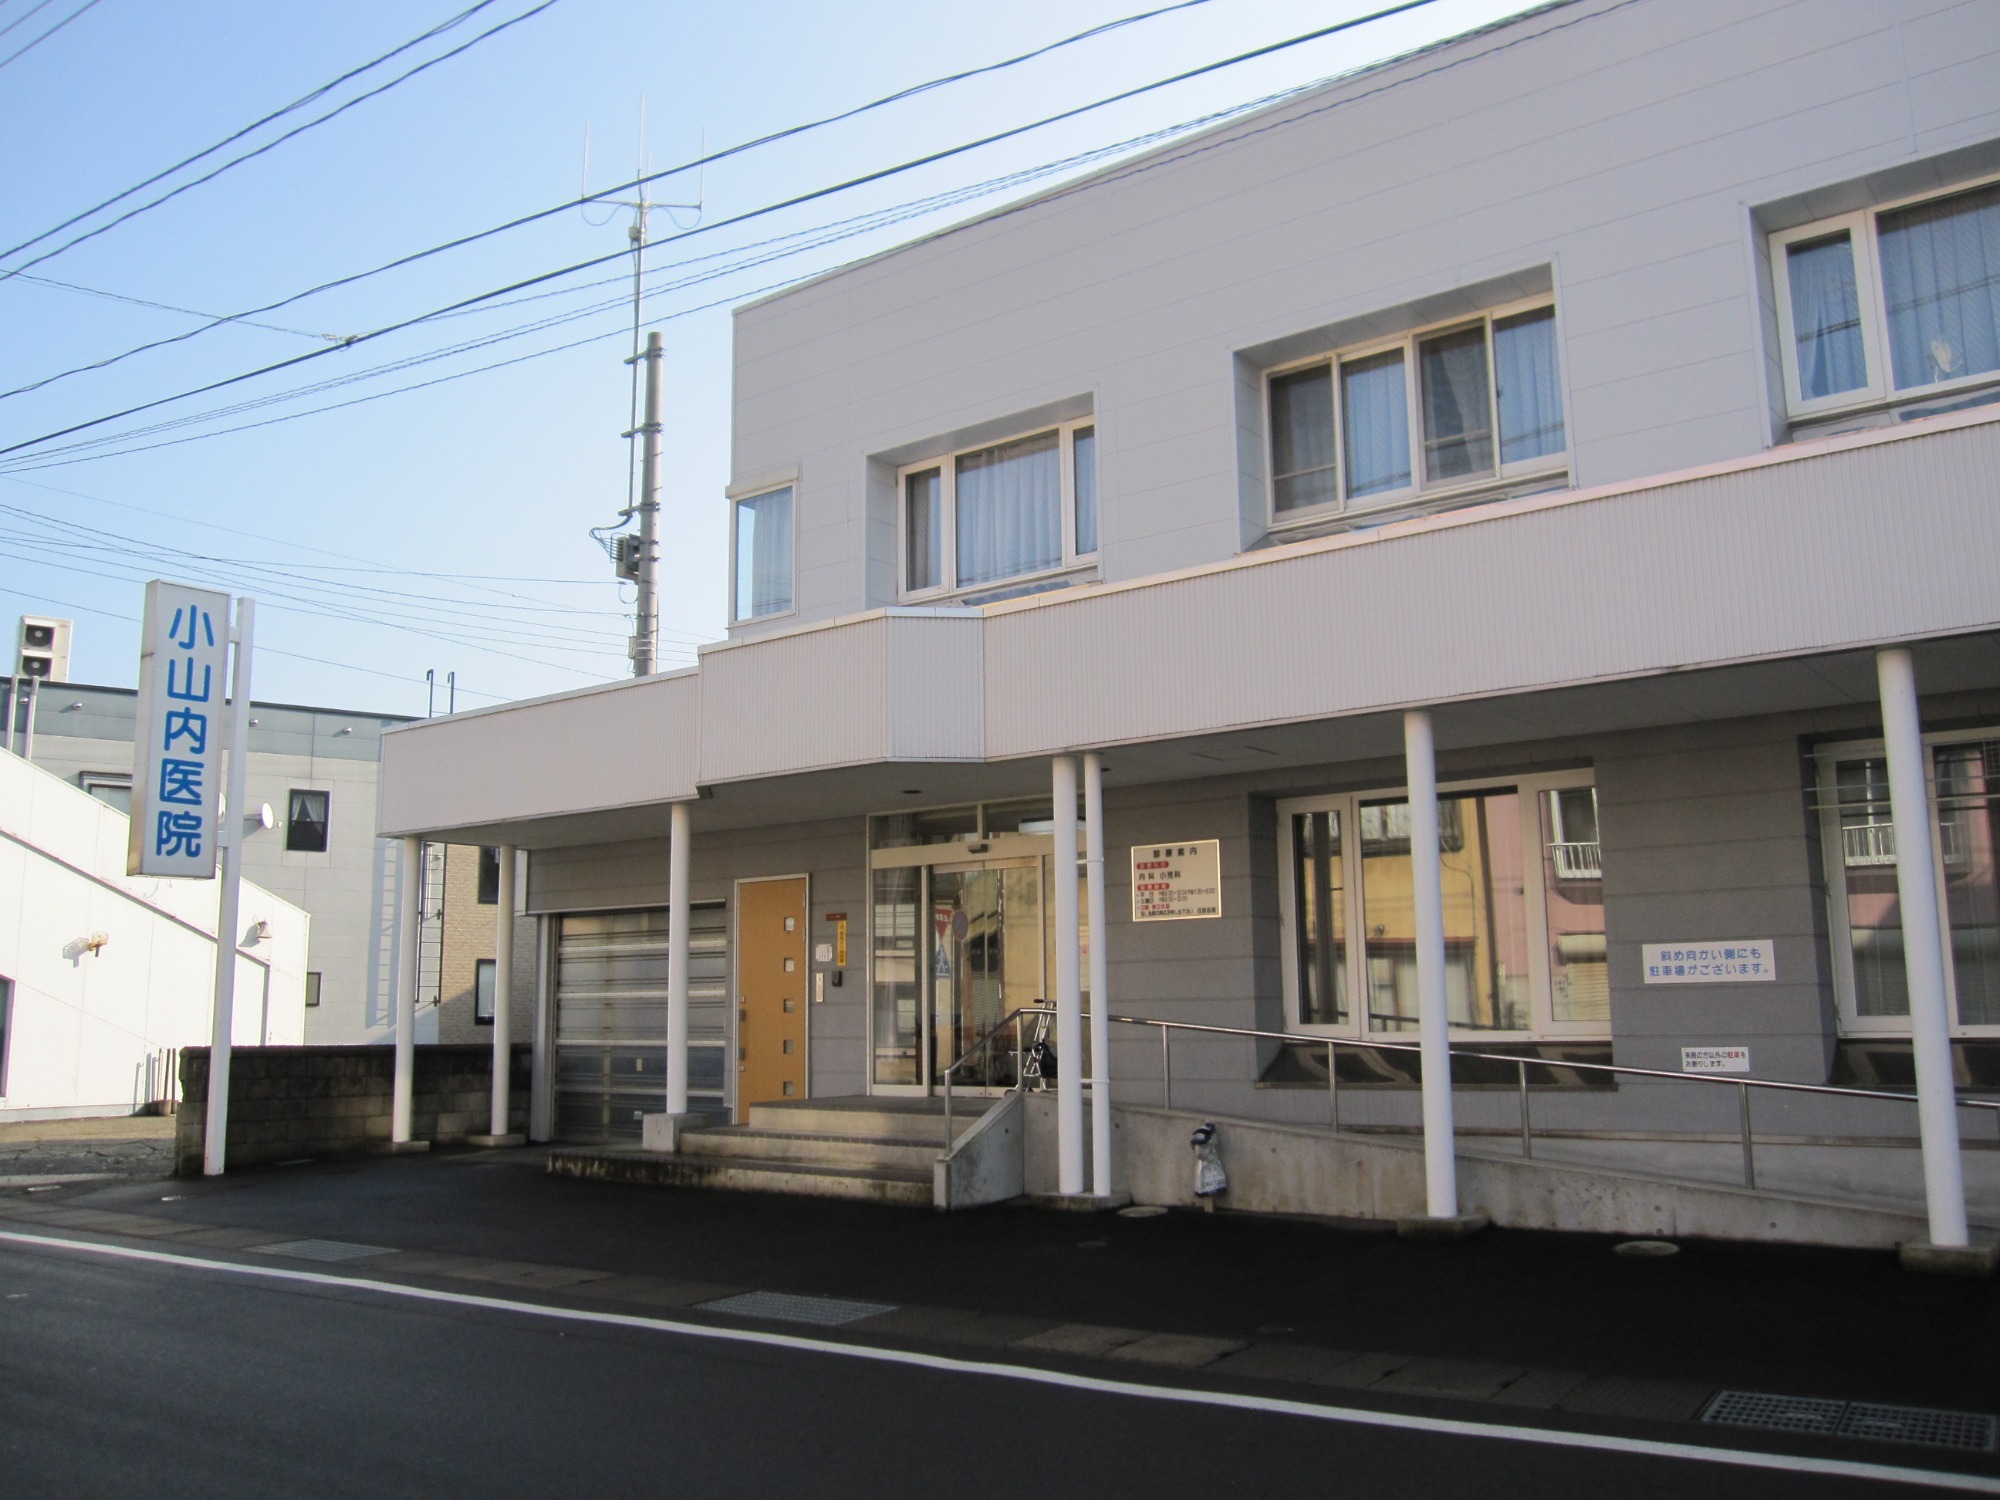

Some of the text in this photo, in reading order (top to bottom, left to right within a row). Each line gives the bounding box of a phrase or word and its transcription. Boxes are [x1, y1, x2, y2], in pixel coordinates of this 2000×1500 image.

[155, 604, 214, 858] 小山内医院
[1160, 871, 1181, 880] 小児科
[1660, 948, 1761, 961] 斜め向かい側にも
[1649, 963, 1769, 976] 駐車場がございます。
